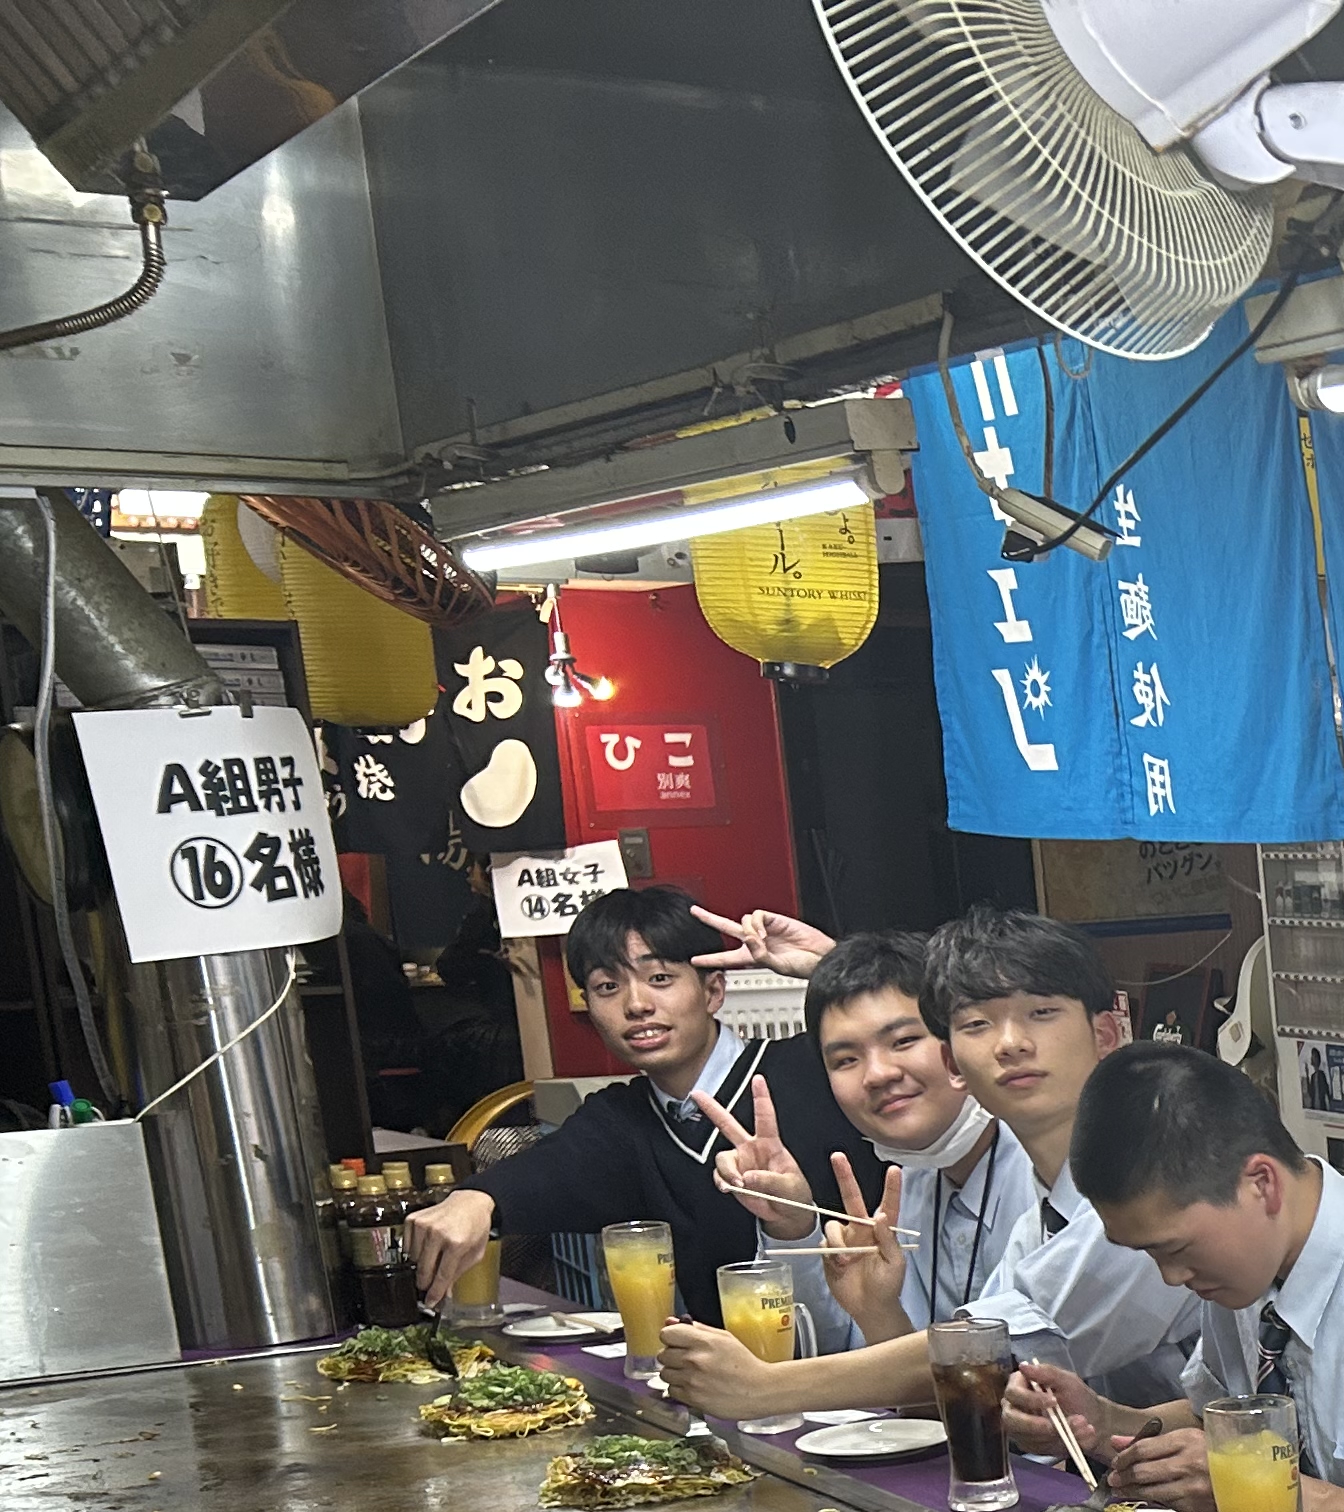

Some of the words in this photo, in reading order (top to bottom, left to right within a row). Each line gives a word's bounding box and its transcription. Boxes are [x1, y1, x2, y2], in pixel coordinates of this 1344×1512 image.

[758, 586, 823, 600] SUNTORY
[156, 756, 304, 817] A組男子
[518, 863, 605, 888] A組女子
